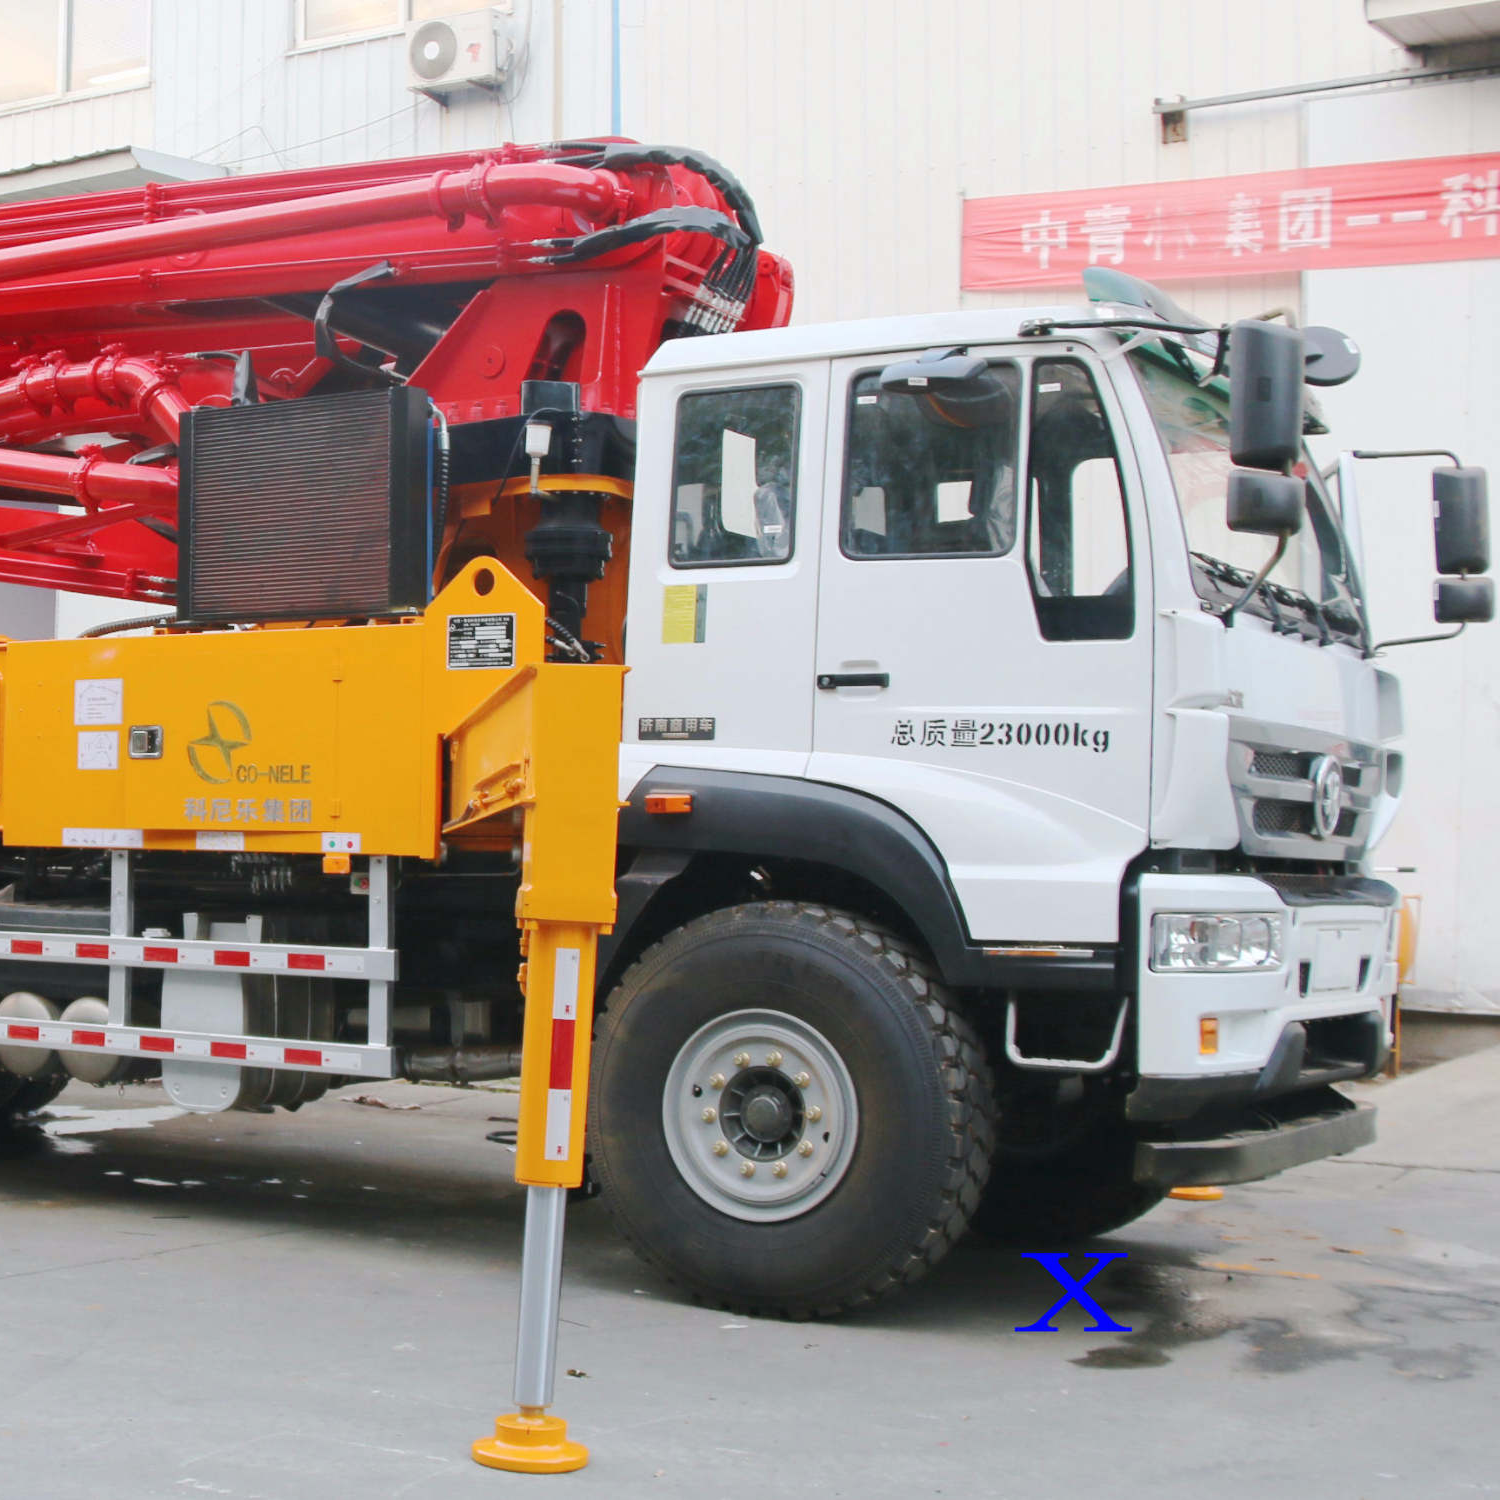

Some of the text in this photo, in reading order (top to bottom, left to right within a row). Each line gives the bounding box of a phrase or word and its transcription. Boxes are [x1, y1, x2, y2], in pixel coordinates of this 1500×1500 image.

[236, 765, 311, 784] CO-NELE
[183, 797, 312, 823] 科尼乐集团
